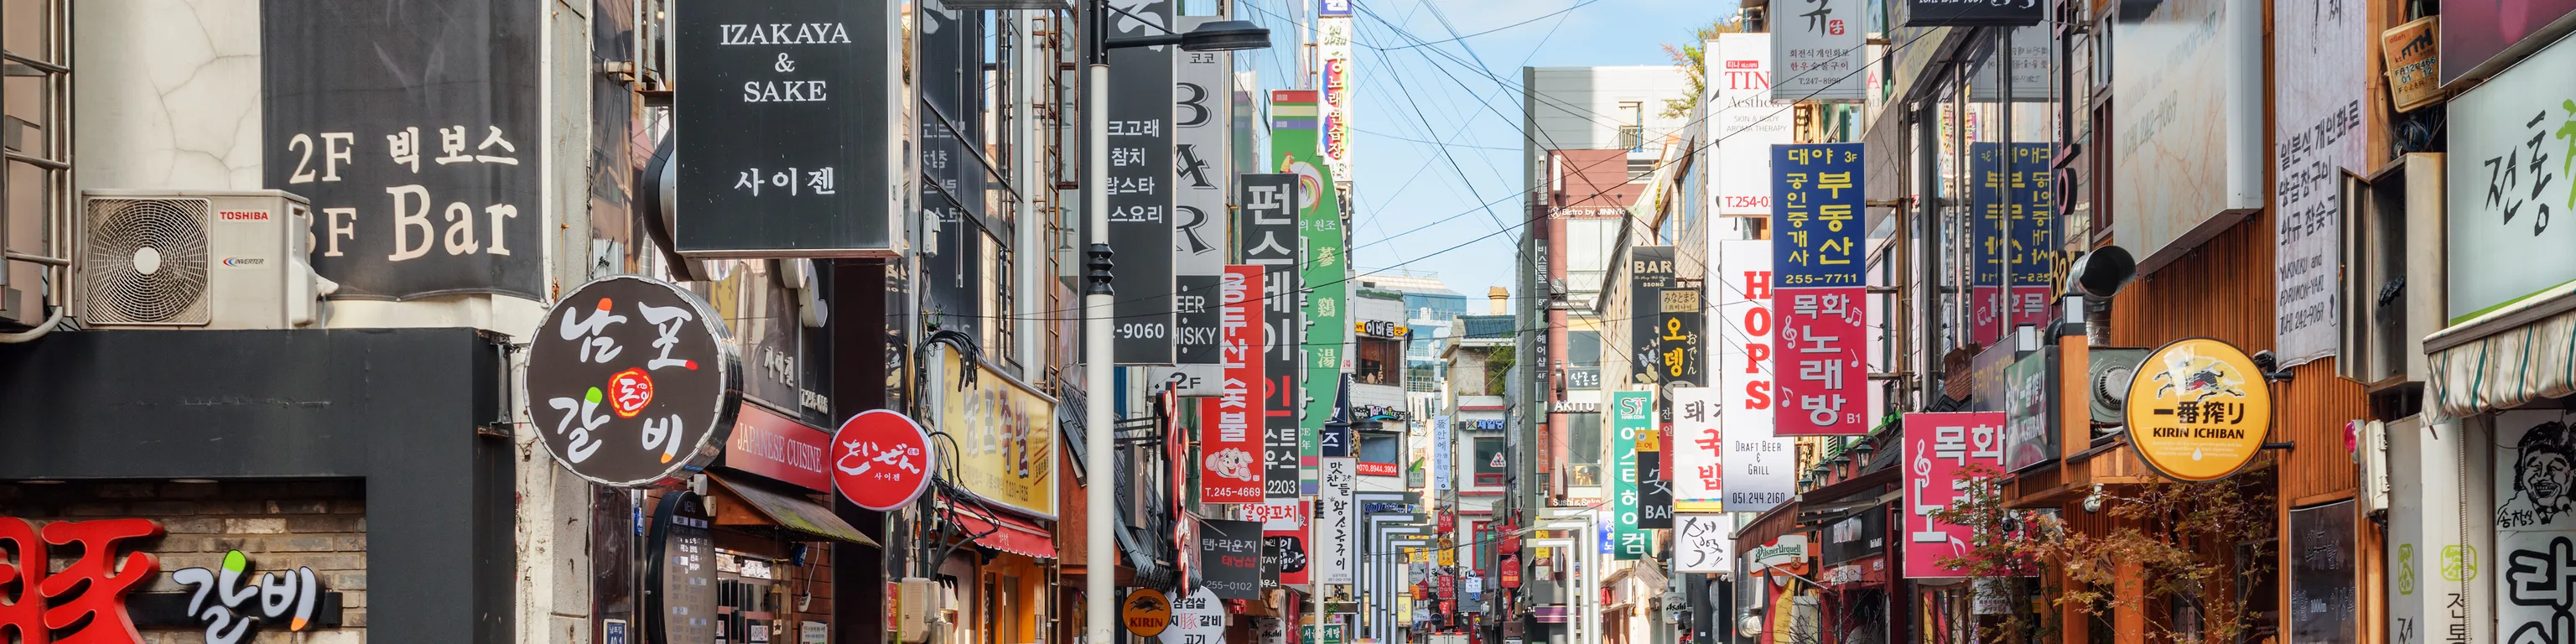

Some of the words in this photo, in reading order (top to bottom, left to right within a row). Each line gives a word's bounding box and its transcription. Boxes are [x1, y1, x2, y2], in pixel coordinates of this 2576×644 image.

[721, 23, 850, 45] IZAKAYA
[775, 53, 795, 72] &
[1189, 54, 1215, 65] 코코
[1789, 49, 1814, 58] 회전식
[1815, 49, 1850, 58] 개인화로
[2394, 55, 2402, 64] kt
[1725, 70, 1770, 90] TIN
[2401, 75, 2412, 85] 01
[2423, 66, 2433, 78] 12
[744, 80, 827, 102] SAKE
[1108, 119, 1160, 138] 크고래
[2280, 127, 2312, 172] 일본식
[2314, 99, 2360, 151] 개인화로
[288, 132, 355, 184] 2F
[387, 127, 420, 174] 빅
[435, 126, 519, 166] 보스
[1111, 148, 1145, 166] 참치
[1788, 148, 1834, 165] 대야
[1844, 151, 1858, 163] 3F
[1176, 82, 1218, 257] BAR
[2484, 109, 2553, 237] 전통
[735, 167, 835, 196] 사이젠
[2279, 154, 2332, 208] 양곱창구이
[220, 211, 268, 221] TOSHIBA
[386, 184, 518, 262] Bar
[1108, 205, 1162, 224] 스요리
[1585, 209, 1595, 218] by
[1786, 173, 1810, 267] 공인중개사
[1817, 171, 1854, 265] 부동산
[2281, 211, 2303, 247] 와규
[2305, 194, 2337, 237] 참숯구
[1313, 219, 1337, 231] 원조
[1537, 246, 1547, 283] 비스트로
[1633, 261, 1673, 273] BAR
[2279, 255, 2309, 283] YAKINIKU
[2310, 247, 2323, 270] and
[1785, 273, 1857, 284] 255-7711
[1176, 296, 1205, 313] EER
[1664, 292, 1696, 304] みなとまち
[1794, 293, 1850, 319] 목화
[2294, 301, 2325, 330] 242-9069
[560, 298, 699, 371] 남포
[1114, 323, 1164, 339] -9060
[1176, 327, 1216, 345] HISKY
[1365, 320, 1394, 337] 이바돔
[1663, 317, 1687, 377] 오뎅
[1744, 271, 1772, 410] HOPS
[1536, 334, 1546, 368] 헤어샵
[1686, 331, 1697, 375] おでん
[1170, 371, 1201, 390] 2F
[1800, 325, 1847, 426] 노래방
[1554, 400, 1595, 412] AKITU
[2153, 401, 2245, 425] 一番搾り
[549, 387, 683, 464] 갈비
[1847, 413, 1861, 424] B1
[1265, 428, 1296, 447] 스트
[2153, 428, 2189, 439] KIRIN
[2194, 428, 2245, 439] ICHIBAN
[737, 422, 786, 464] JAPANESE
[786, 438, 822, 474] CUISINE
[1735, 440, 1759, 452] DRAFT
[1762, 440, 1782, 452] BEER
[1934, 424, 2006, 467] 목화
[1265, 450, 1296, 470] 우스
[1748, 464, 1770, 475] GRILL
[874, 472, 900, 481] 사이젠
[1205, 487, 1261, 498] T.245-4669
[1265, 480, 1296, 494] 2203
[1732, 492, 1785, 505] 051.244.2160
[1256, 505, 1296, 525] 양꼬치
[1221, 554, 1257, 568] 태닝샵
[1259, 556, 1278, 564] TAY
[1206, 580, 1253, 591] 255-0102
[173, 550, 316, 644] 갈비
[1172, 597, 1206, 610] 삼겹살
[1130, 617, 1163, 627] KIRIN
[1199, 615, 1222, 627] 갈비
[1262, 630, 1282, 638] Asahi
